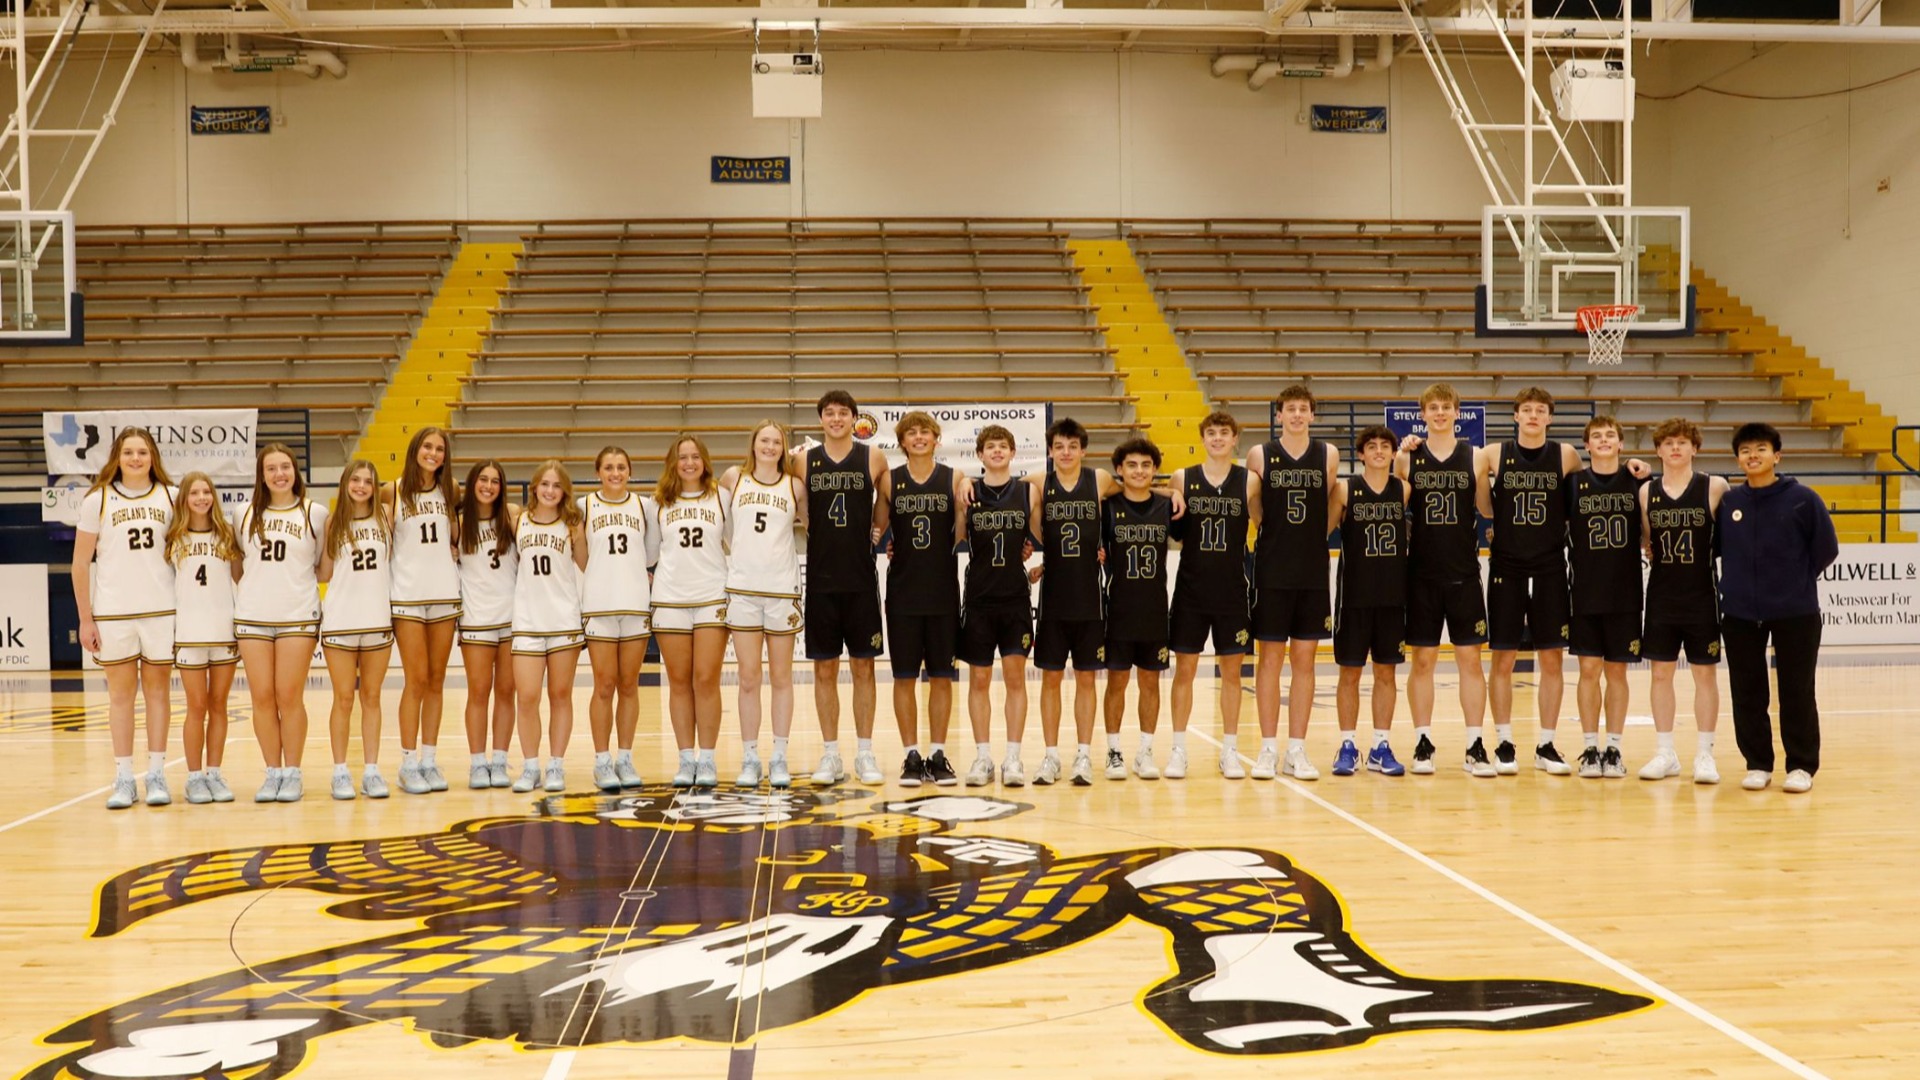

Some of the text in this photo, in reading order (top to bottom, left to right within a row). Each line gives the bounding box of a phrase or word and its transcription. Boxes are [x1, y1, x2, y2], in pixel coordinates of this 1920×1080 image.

[204, 111, 257, 119] VISITOR
[1315, 120, 1384, 129] OVERFLOW
[1331, 110, 1367, 118] HOME
[195, 121, 266, 131] STUDENTS
[717, 159, 785, 168] VISITOR
[719, 170, 783, 179] ADULTS
[932, 411, 960, 421] YOU
[964, 409, 1036, 420] SPONSORS
[110, 425, 250, 445] JHNSON
[194, 448, 248, 458] SURGERY
[811, 471, 865, 492] SCOTS
[1270, 469, 1322, 488] SCOTS
[1414, 471, 1469, 489] SCOTS
[1503, 471, 1558, 490] SCOTS
[222, 492, 249, 504] M.D.
[772, 494, 788, 513] PARK
[895, 493, 948, 514] SCOTS
[1188, 497, 1242, 516] SCOTS
[1287, 490, 1306, 525] 5
[1425, 491, 1458, 525] 21
[1513, 491, 1547, 525] 15
[1579, 493, 1635, 514] SCOTS
[112, 506, 166, 527] HIGHLAND PARK
[666, 507, 717, 526] HIGHLAND PARK
[828, 493, 847, 527] 4
[1046, 500, 1096, 521] SCOTS
[1353, 502, 1402, 521] SCOTS
[1650, 508, 1705, 529] SCOTS
[285, 520, 303, 540] PARK
[592, 513, 641, 533] HIGHLAND PARK
[754, 511, 768, 533] 5
[972, 511, 1026, 531] SCOTS
[1588, 514, 1628, 549] 20
[128, 528, 154, 550] 23
[420, 522, 438, 544] 11
[679, 527, 703, 548] 32
[912, 515, 931, 549] 3
[1061, 522, 1080, 557] 2
[1115, 524, 1167, 543] SCOTS
[1200, 517, 1227, 551] 11
[1365, 523, 1396, 557] 12
[260, 539, 286, 562] 20
[550, 535, 566, 555] PARK
[608, 533, 628, 555] 13
[992, 532, 1006, 567] 1
[1660, 530, 1694, 564] 14
[352, 548, 377, 571] 22
[488, 549, 500, 570] 3
[532, 554, 552, 576] 10
[1126, 545, 1157, 579] 13
[195, 564, 207, 586] 4
[1817, 563, 1902, 581] ULWELL
[1828, 592, 1911, 606] Menswear For
[1822, 612, 1843, 625] The
[1846, 611, 1893, 625] Modern
[6, 655, 30, 664] FDIC
